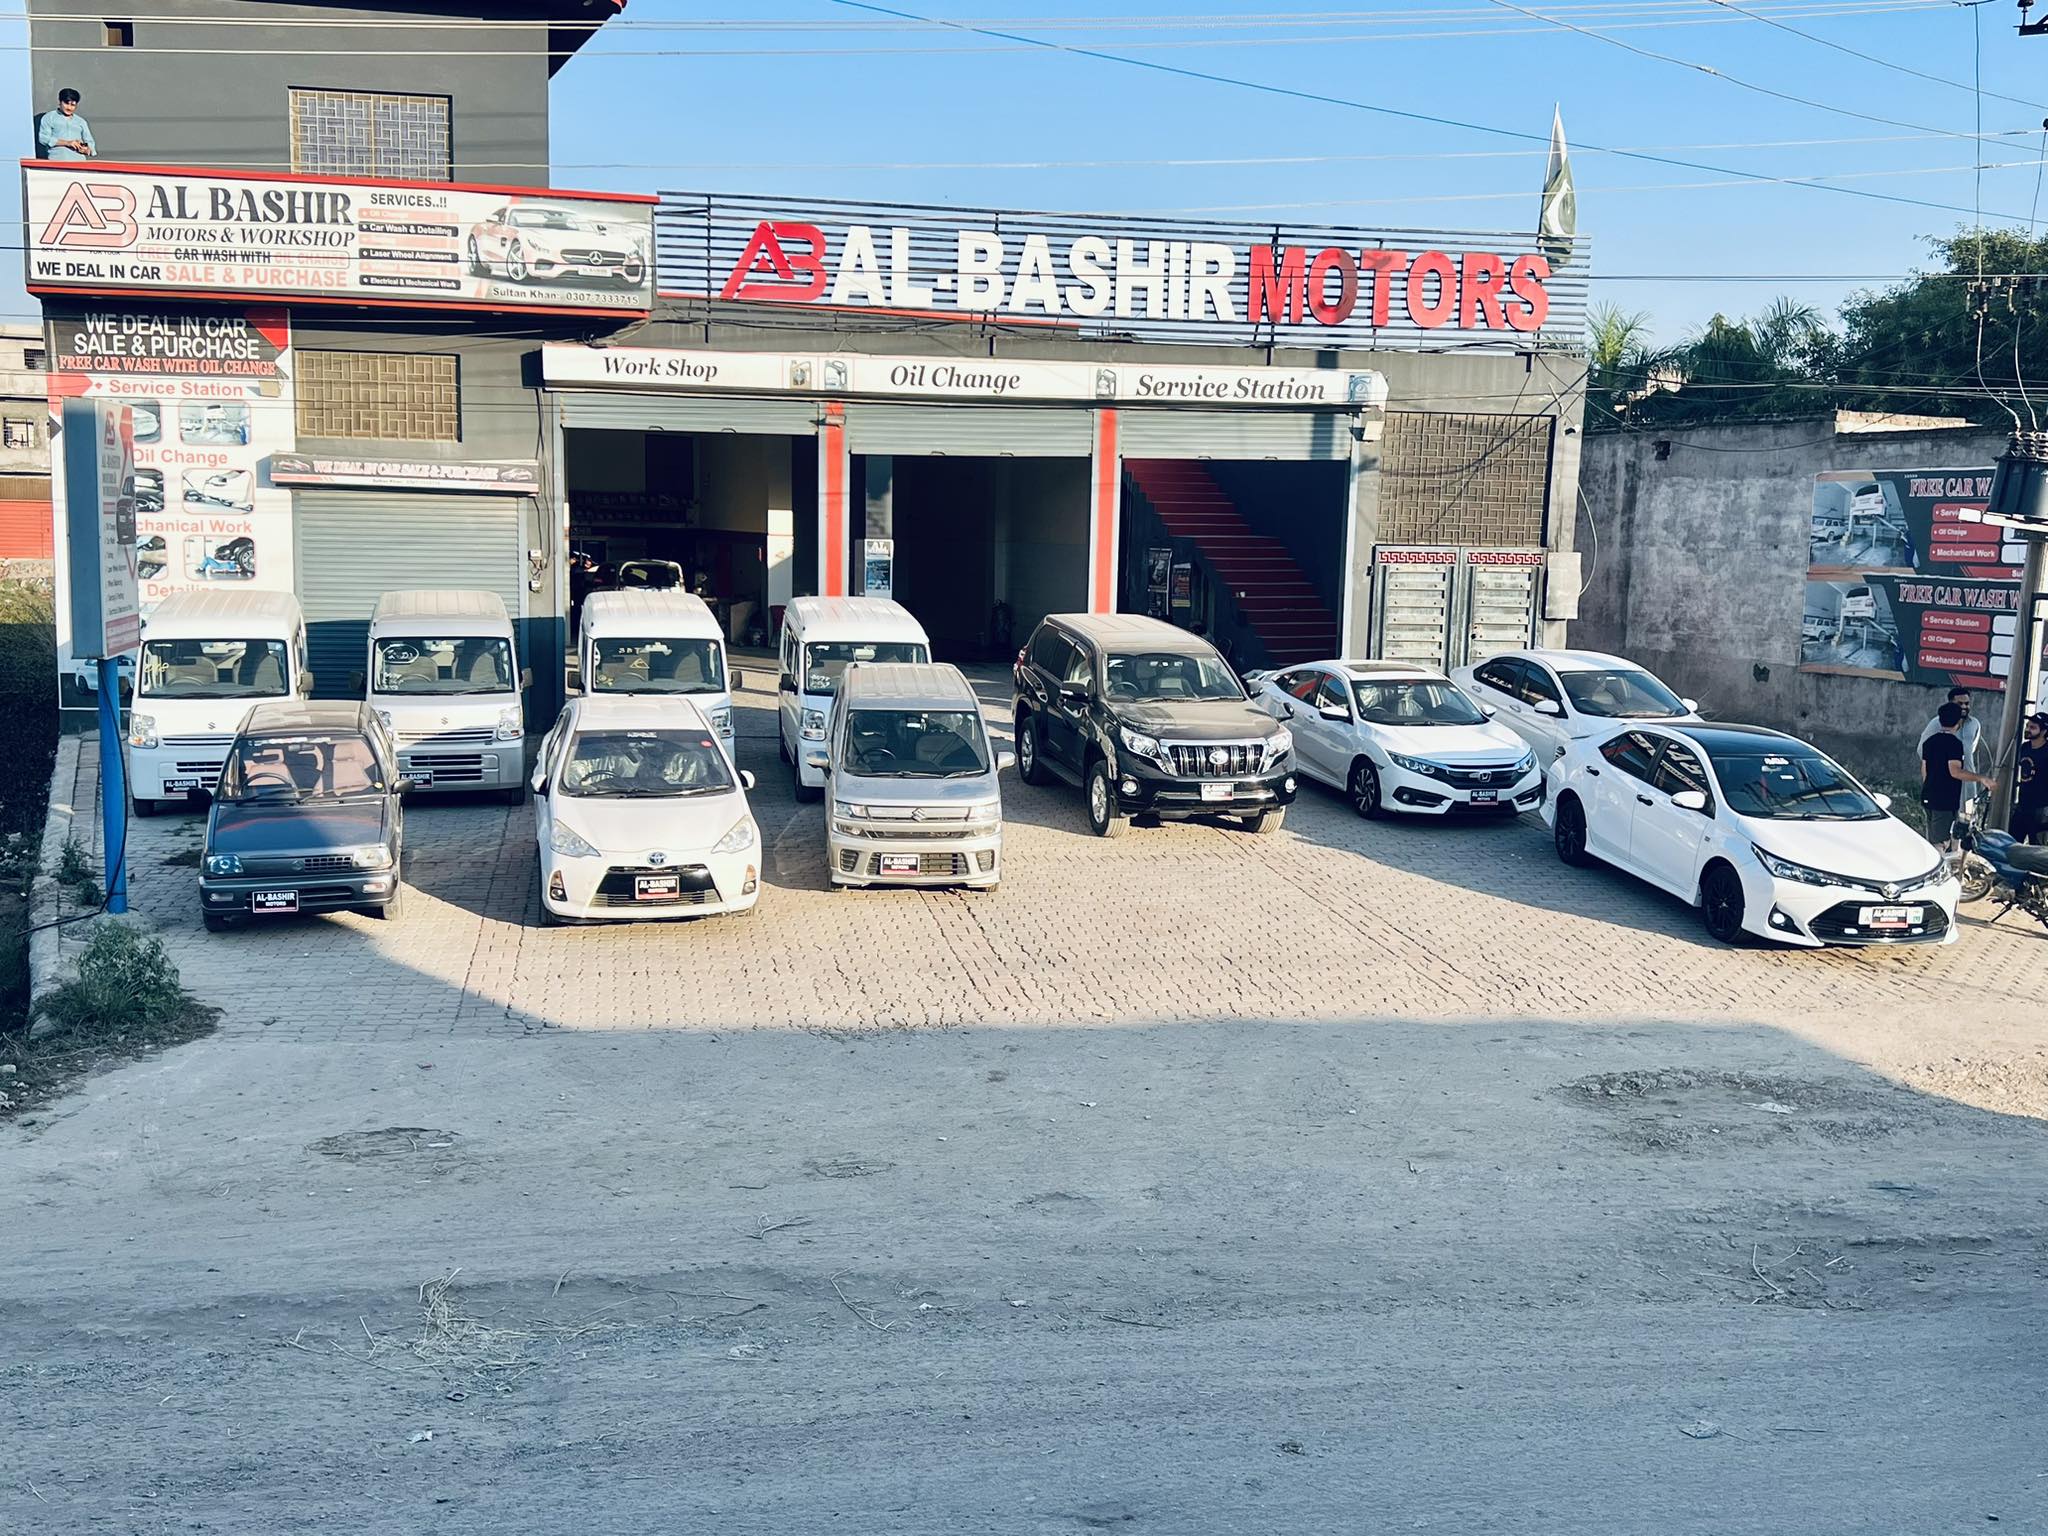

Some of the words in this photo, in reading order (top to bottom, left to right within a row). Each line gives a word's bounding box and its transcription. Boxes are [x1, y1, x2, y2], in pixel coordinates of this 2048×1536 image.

[146, 185, 199, 220] AL
[208, 187, 354, 225] BASHIR
[146, 227, 217, 243] MOTORS
[220, 229, 235, 243] &
[240, 227, 355, 248] WORKSHOP
[369, 223, 384, 231] Car
[385, 224, 408, 233] Wash
[408, 225, 416, 234] &
[174, 248, 201, 261] CAR
[202, 249, 238, 263] WASH
[239, 250, 271, 264] WITH
[37, 260, 62, 276] WE
[65, 263, 105, 278] DEAL
[109, 264, 125, 278] IN
[129, 264, 161, 280] CAR
[165, 265, 215, 282] SALE
[223, 267, 237, 284] &
[243, 268, 348, 288] PURCHASE
[831, 226, 1237, 321] AL-BASHIR
[1248, 245, 1550, 331] MOTORS
[492, 287, 527, 298] Sultan
[85, 312, 117, 334] WE
[122, 314, 176, 336] DEAL
[180, 316, 201, 337] IN
[205, 317, 247, 338] CAR
[74, 333, 126, 355] SALE
[131, 334, 146, 356] &
[150, 336, 261, 359] PURCHASE
[58, 355, 93, 370] FREE
[94, 355, 123, 371] CAR
[124, 356, 162, 372] WASH
[163, 357, 198, 373] WITH
[199, 358, 221, 374] OIL
[221, 360, 276, 376] CHANGE
[602, 356, 662, 376] Work
[665, 356, 718, 382] Shop
[109, 379, 175, 395] Service
[181, 381, 243, 397] Station
[890, 364, 927, 387] Oil
[932, 366, 1021, 394] Change
[1135, 374, 1229, 399] Service
[1233, 377, 1326, 400] Station
[134, 448, 155, 462] Oil
[161, 449, 228, 468] Change
[1909, 478, 1945, 497] FREE
[1946, 477, 1974, 497] CAR
[1940, 508, 1960, 517] Servi
[137, 519, 204, 533] chanical
[209, 520, 252, 533] Work
[1936, 548, 1975, 556] Mechanical
[1976, 549, 1995, 557] Work
[1898, 583, 1933, 604] FREE
[1934, 586, 1962, 606] CAR
[1963, 589, 2007, 609] WASH
[1929, 616, 1954, 624] Service
[1955, 618, 1980, 627] Station
[1926, 655, 1964, 665] Mechanical
[1965, 659, 1983, 667] Work
[256, 893, 296, 902] AL-BASHIR
